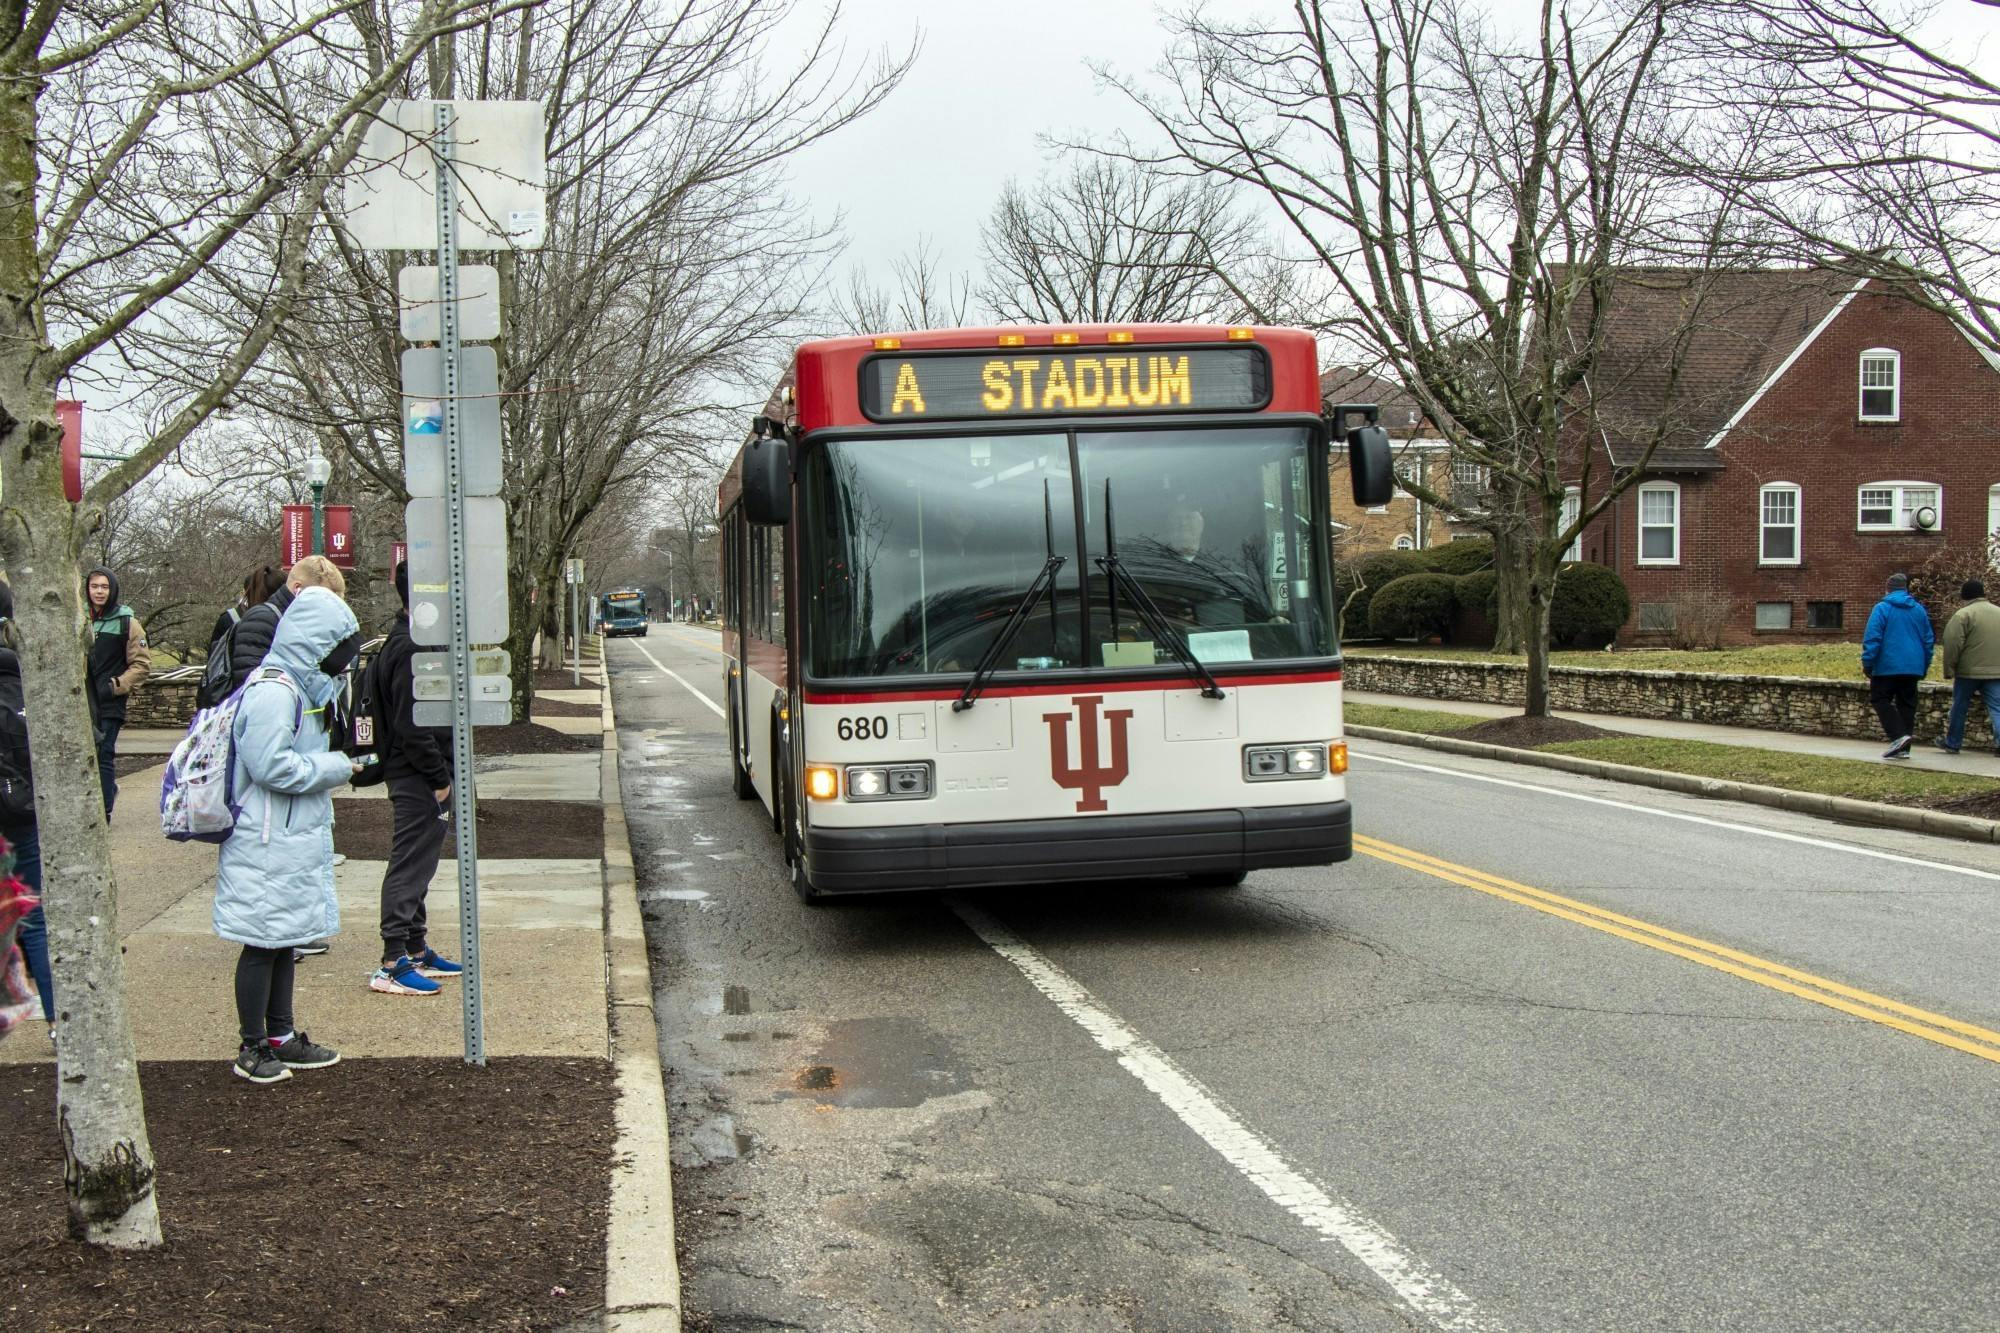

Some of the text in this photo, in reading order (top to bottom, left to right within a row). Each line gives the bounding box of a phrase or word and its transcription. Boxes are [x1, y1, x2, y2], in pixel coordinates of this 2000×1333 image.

[892, 356, 1192, 413] A STADIUM
[837, 716, 888, 741] 680
[1042, 695, 1134, 812] IU
